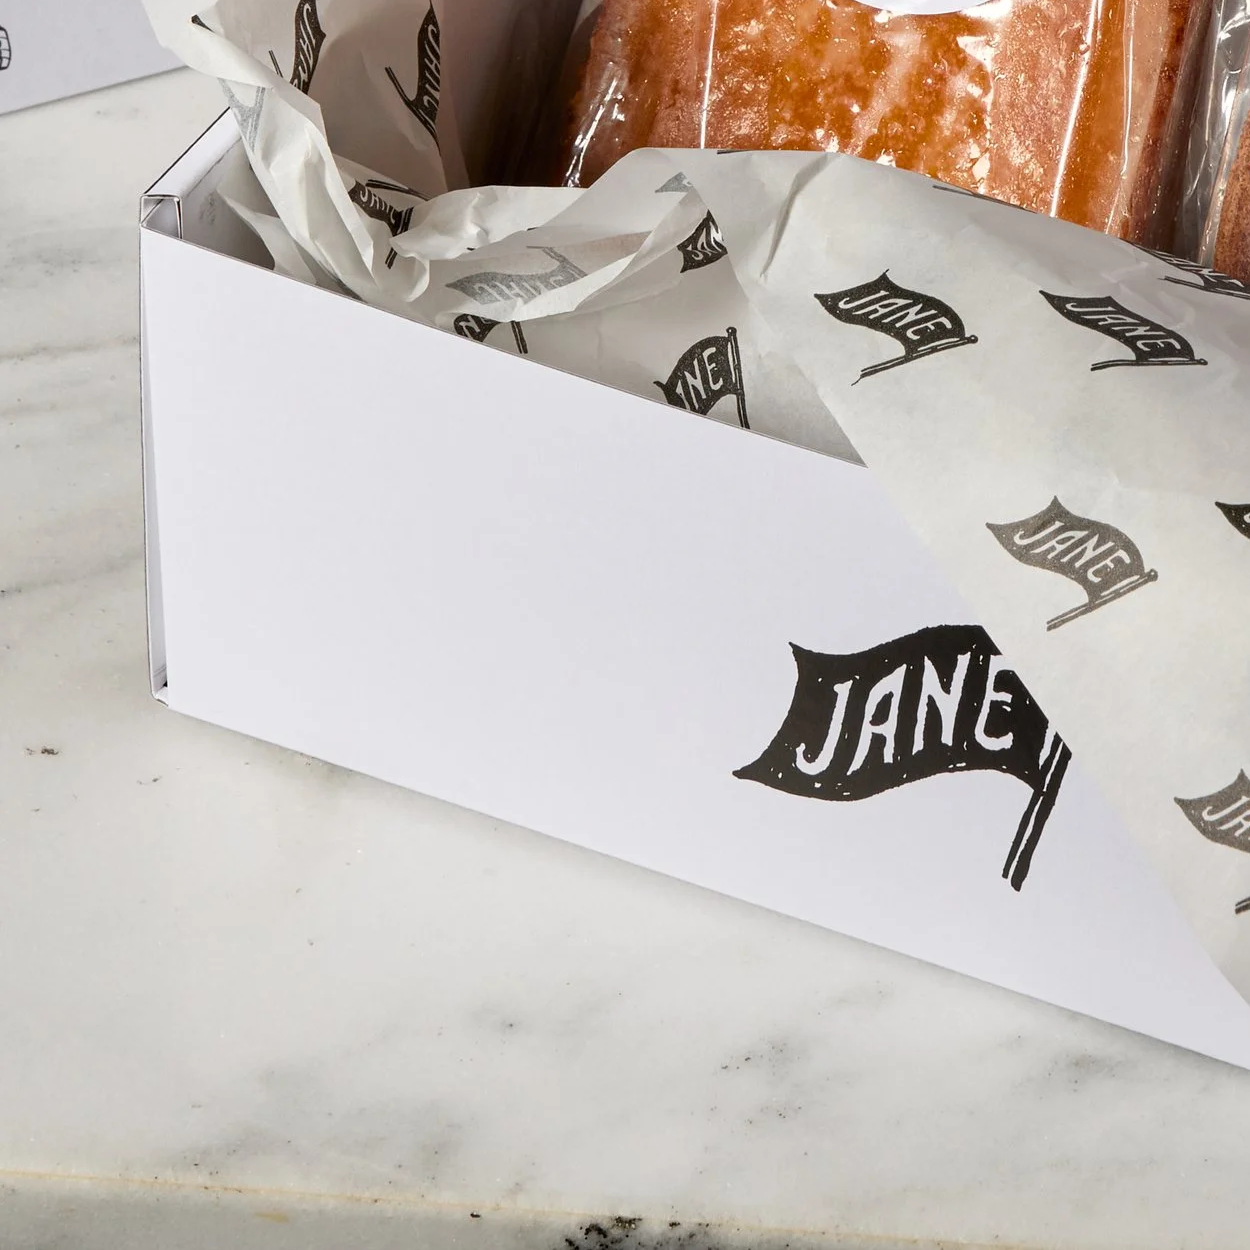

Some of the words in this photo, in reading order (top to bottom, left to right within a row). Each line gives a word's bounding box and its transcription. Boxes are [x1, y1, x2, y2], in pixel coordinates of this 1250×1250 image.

[691, 220, 724, 260] JAN
[836, 289, 953, 342] JANE
[1064, 300, 1182, 353] JANE
[1013, 520, 1133, 583] JANE
[795, 651, 1015, 778] JANE
